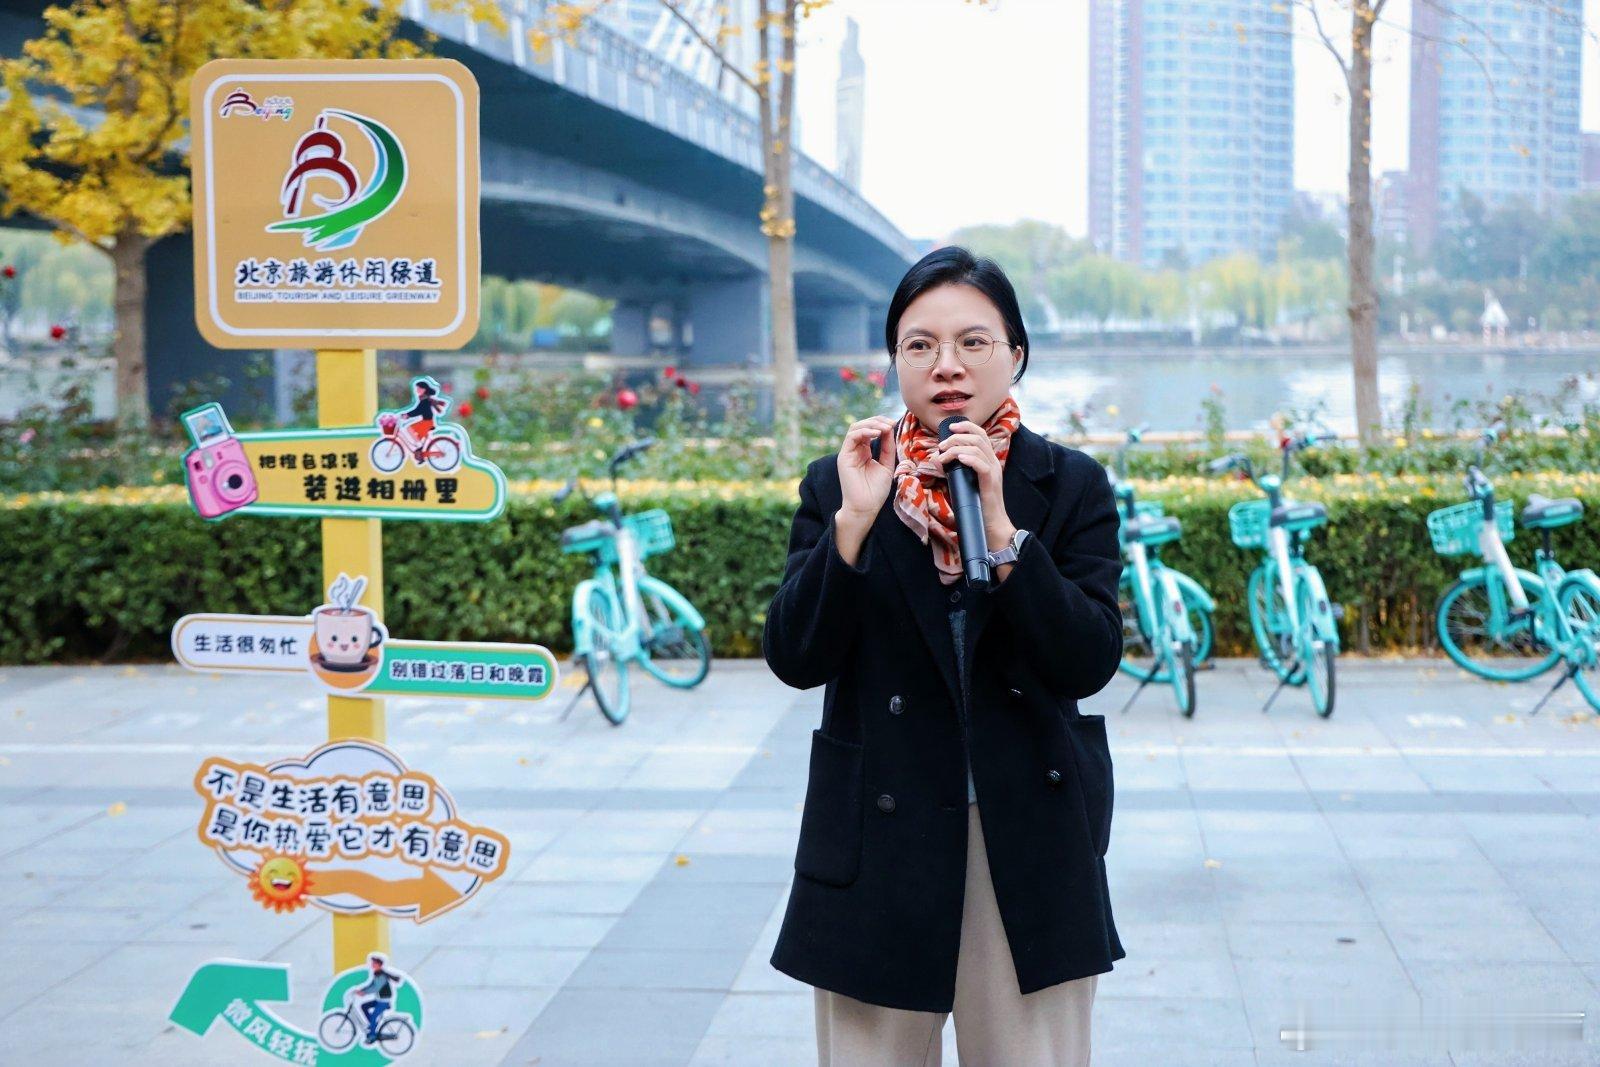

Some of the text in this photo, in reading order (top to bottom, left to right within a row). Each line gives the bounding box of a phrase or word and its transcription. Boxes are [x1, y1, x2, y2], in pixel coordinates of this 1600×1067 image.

[237, 260, 439, 285] 北京旅游休闲绿道
[238, 291, 438, 300] BEIJING TOURISM AND LEISURE GREENWAY
[259, 452, 359, 470] 把橙色浪漫
[303, 474, 459, 504] 装进相册里
[392, 661, 544, 683] 别错过落日和晚霞
[208, 768, 425, 815] 不是生活有意思
[211, 807, 497, 868] 是你热爱它才有意思
